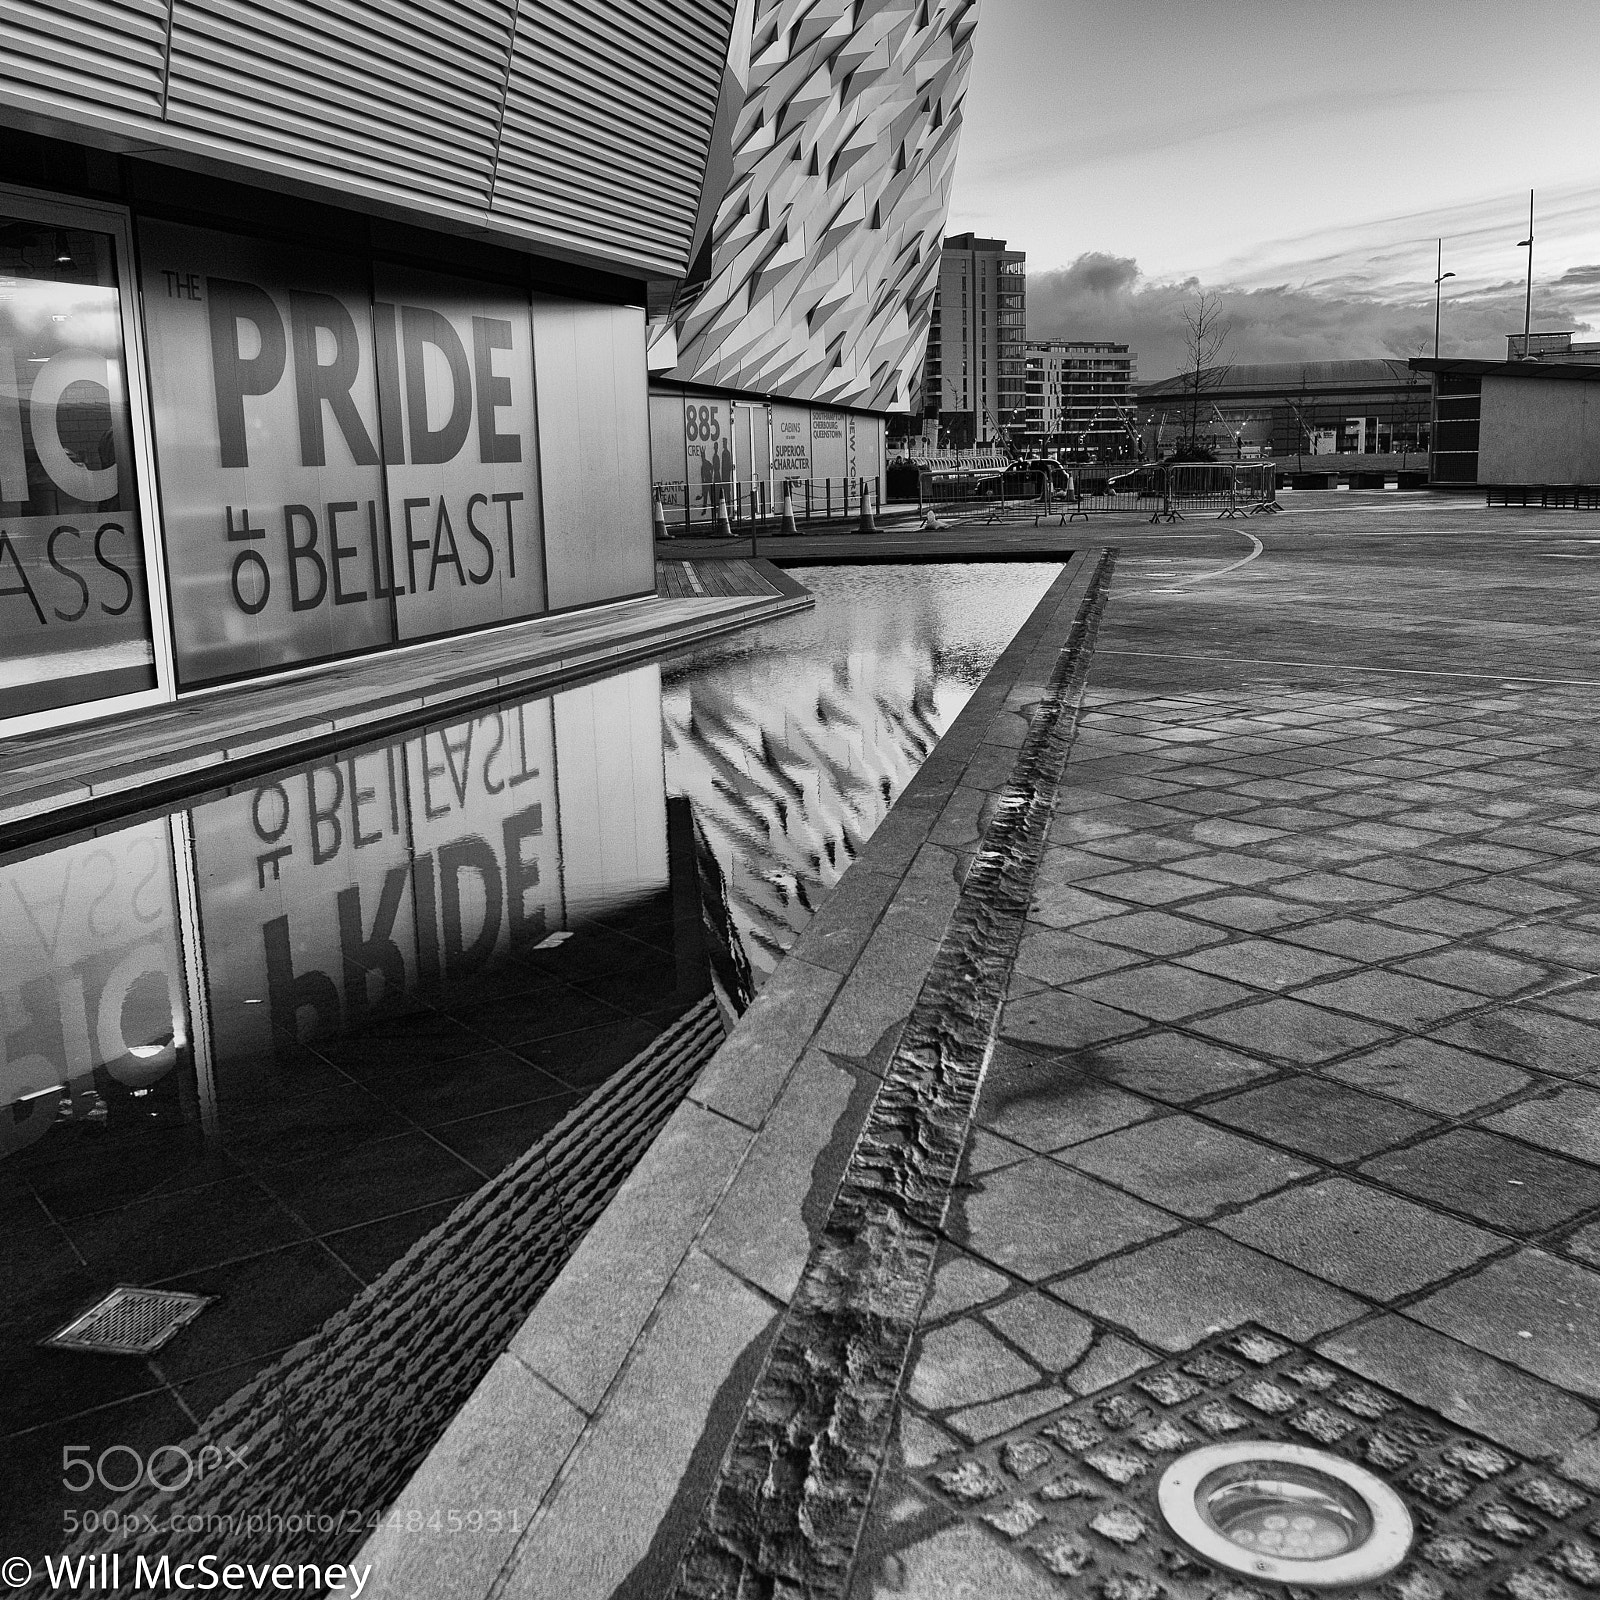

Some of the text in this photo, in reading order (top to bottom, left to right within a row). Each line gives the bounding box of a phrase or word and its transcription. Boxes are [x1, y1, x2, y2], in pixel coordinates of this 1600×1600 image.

[161, 270, 523, 468] THE PRIDE
[687, 405, 720, 441] 885
[780, 422, 801, 433] CABINS
[812, 421, 838, 430] CHERBOURG
[812, 430, 842, 440] QUEENSTOWN
[849, 412, 857, 452] NEW
[775, 445, 805, 457] SUPERIOR
[773, 458, 810, 470] CHARACTER
[225, 491, 524, 615] OF BELFAST
